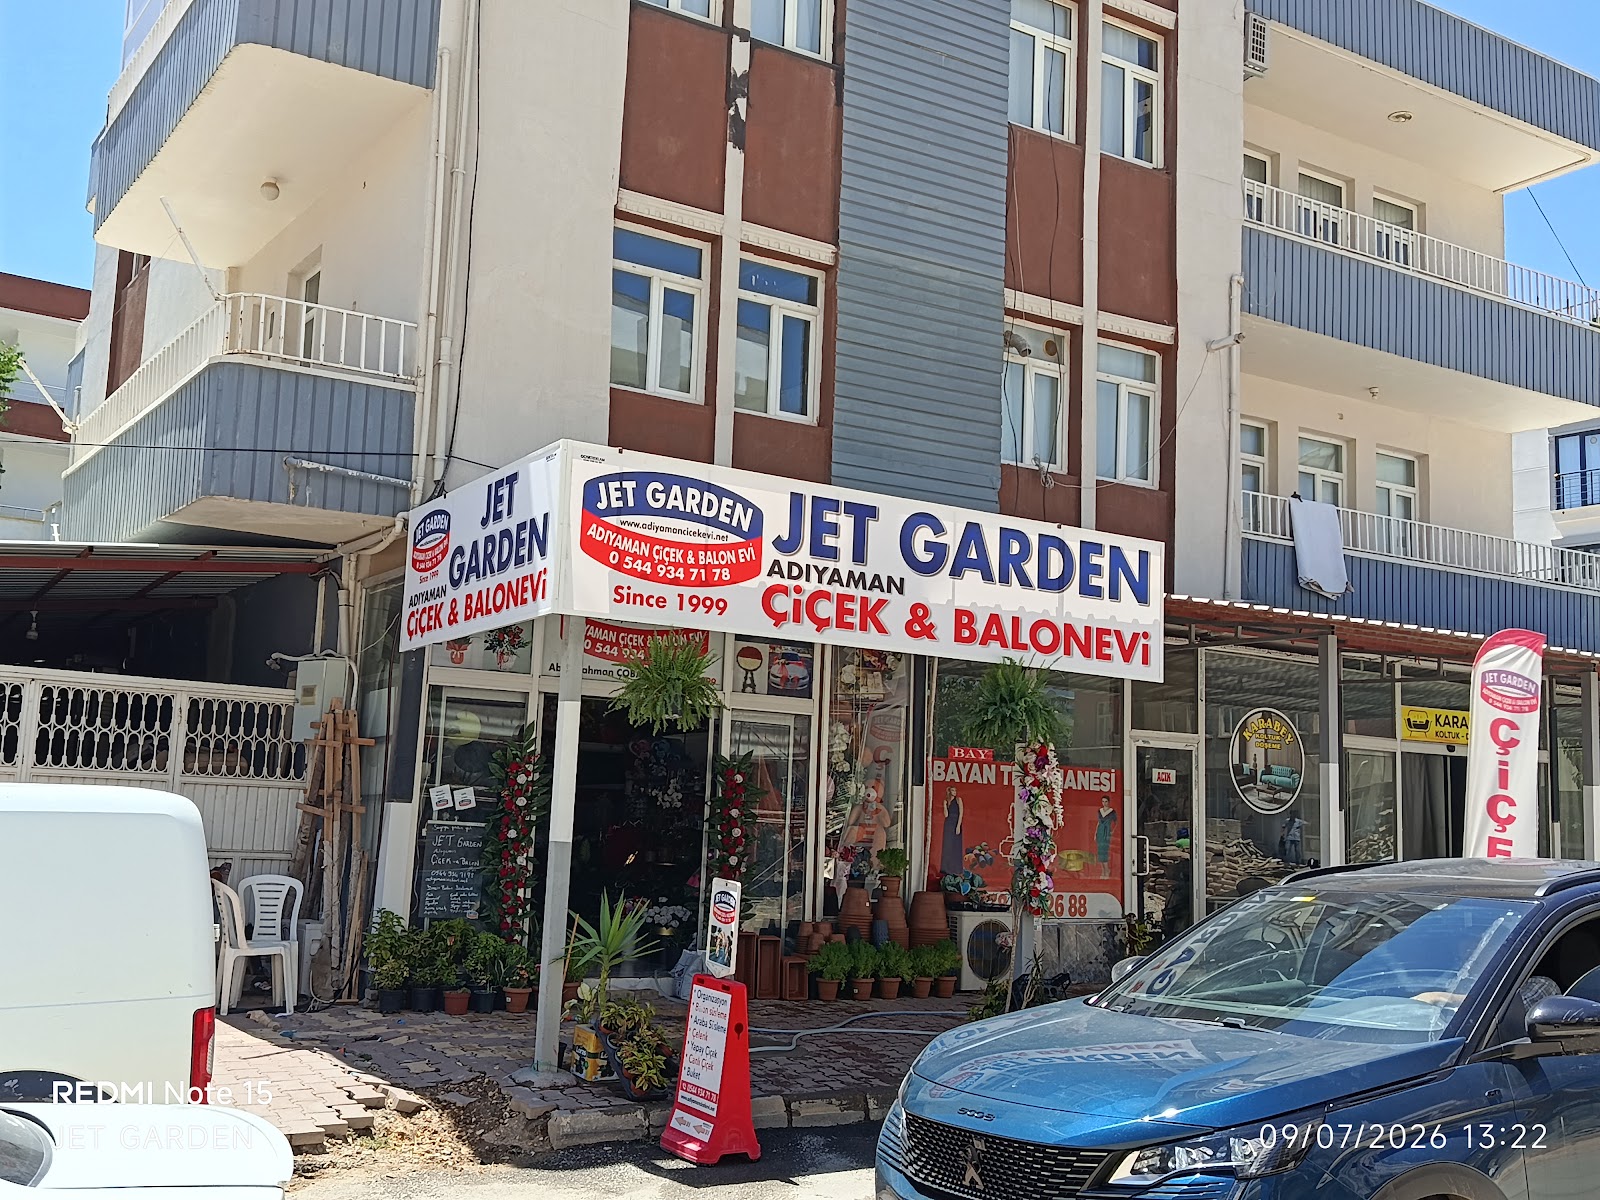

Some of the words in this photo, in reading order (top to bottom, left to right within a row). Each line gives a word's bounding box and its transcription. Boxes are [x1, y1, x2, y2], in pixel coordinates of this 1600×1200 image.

[480, 471, 519, 529] JET
[597, 480, 636, 510] JET
[646, 482, 753, 532] GARDEN
[425, 514, 449, 533] GARDEN
[620, 519, 729, 542] www.adiyamancicekevi.net
[449, 512, 549, 590] GARDEN
[586, 523, 650, 558] ADIYAMAN
[687, 552, 695, 564] &
[698, 549, 736, 565] BALON
[771, 491, 880, 565] JET
[899, 512, 1151, 606] GARDEN
[609, 550, 620, 565] 0
[623, 556, 652, 575] 544
[656, 564, 685, 581] 934
[689, 568, 706, 582] 71
[712, 568, 731, 582] 78
[767, 558, 905, 596] ADIYAMAN
[408, 584, 447, 609] ADIYAMAN
[613, 585, 667, 610] Since
[677, 593, 728, 616] 1999
[448, 597, 459, 626] &
[904, 602, 938, 642] &
[584, 624, 616, 643] YAMAN
[594, 642, 618, 657] 544
[616, 668, 638, 679] ÇOB
[1485, 673, 1498, 683] JET
[1500, 674, 1536, 693] GARDEN
[1243, 718, 1294, 745] KARABEY
[1435, 714, 1468, 729] KARA
[1435, 731, 1460, 739] KOLTUK
[953, 748, 989, 760] BAY
[933, 760, 996, 785] BAYAN
[432, 834, 455, 847] JET
[1068, 894, 1087, 917] 88
[697, 989, 727, 1007] Organizasyon
[693, 1015, 708, 1028] Araba
[692, 1028, 708, 1041] Çelenk
[691, 1041, 704, 1056] Yapay
[687, 1067, 701, 1080] Buket
